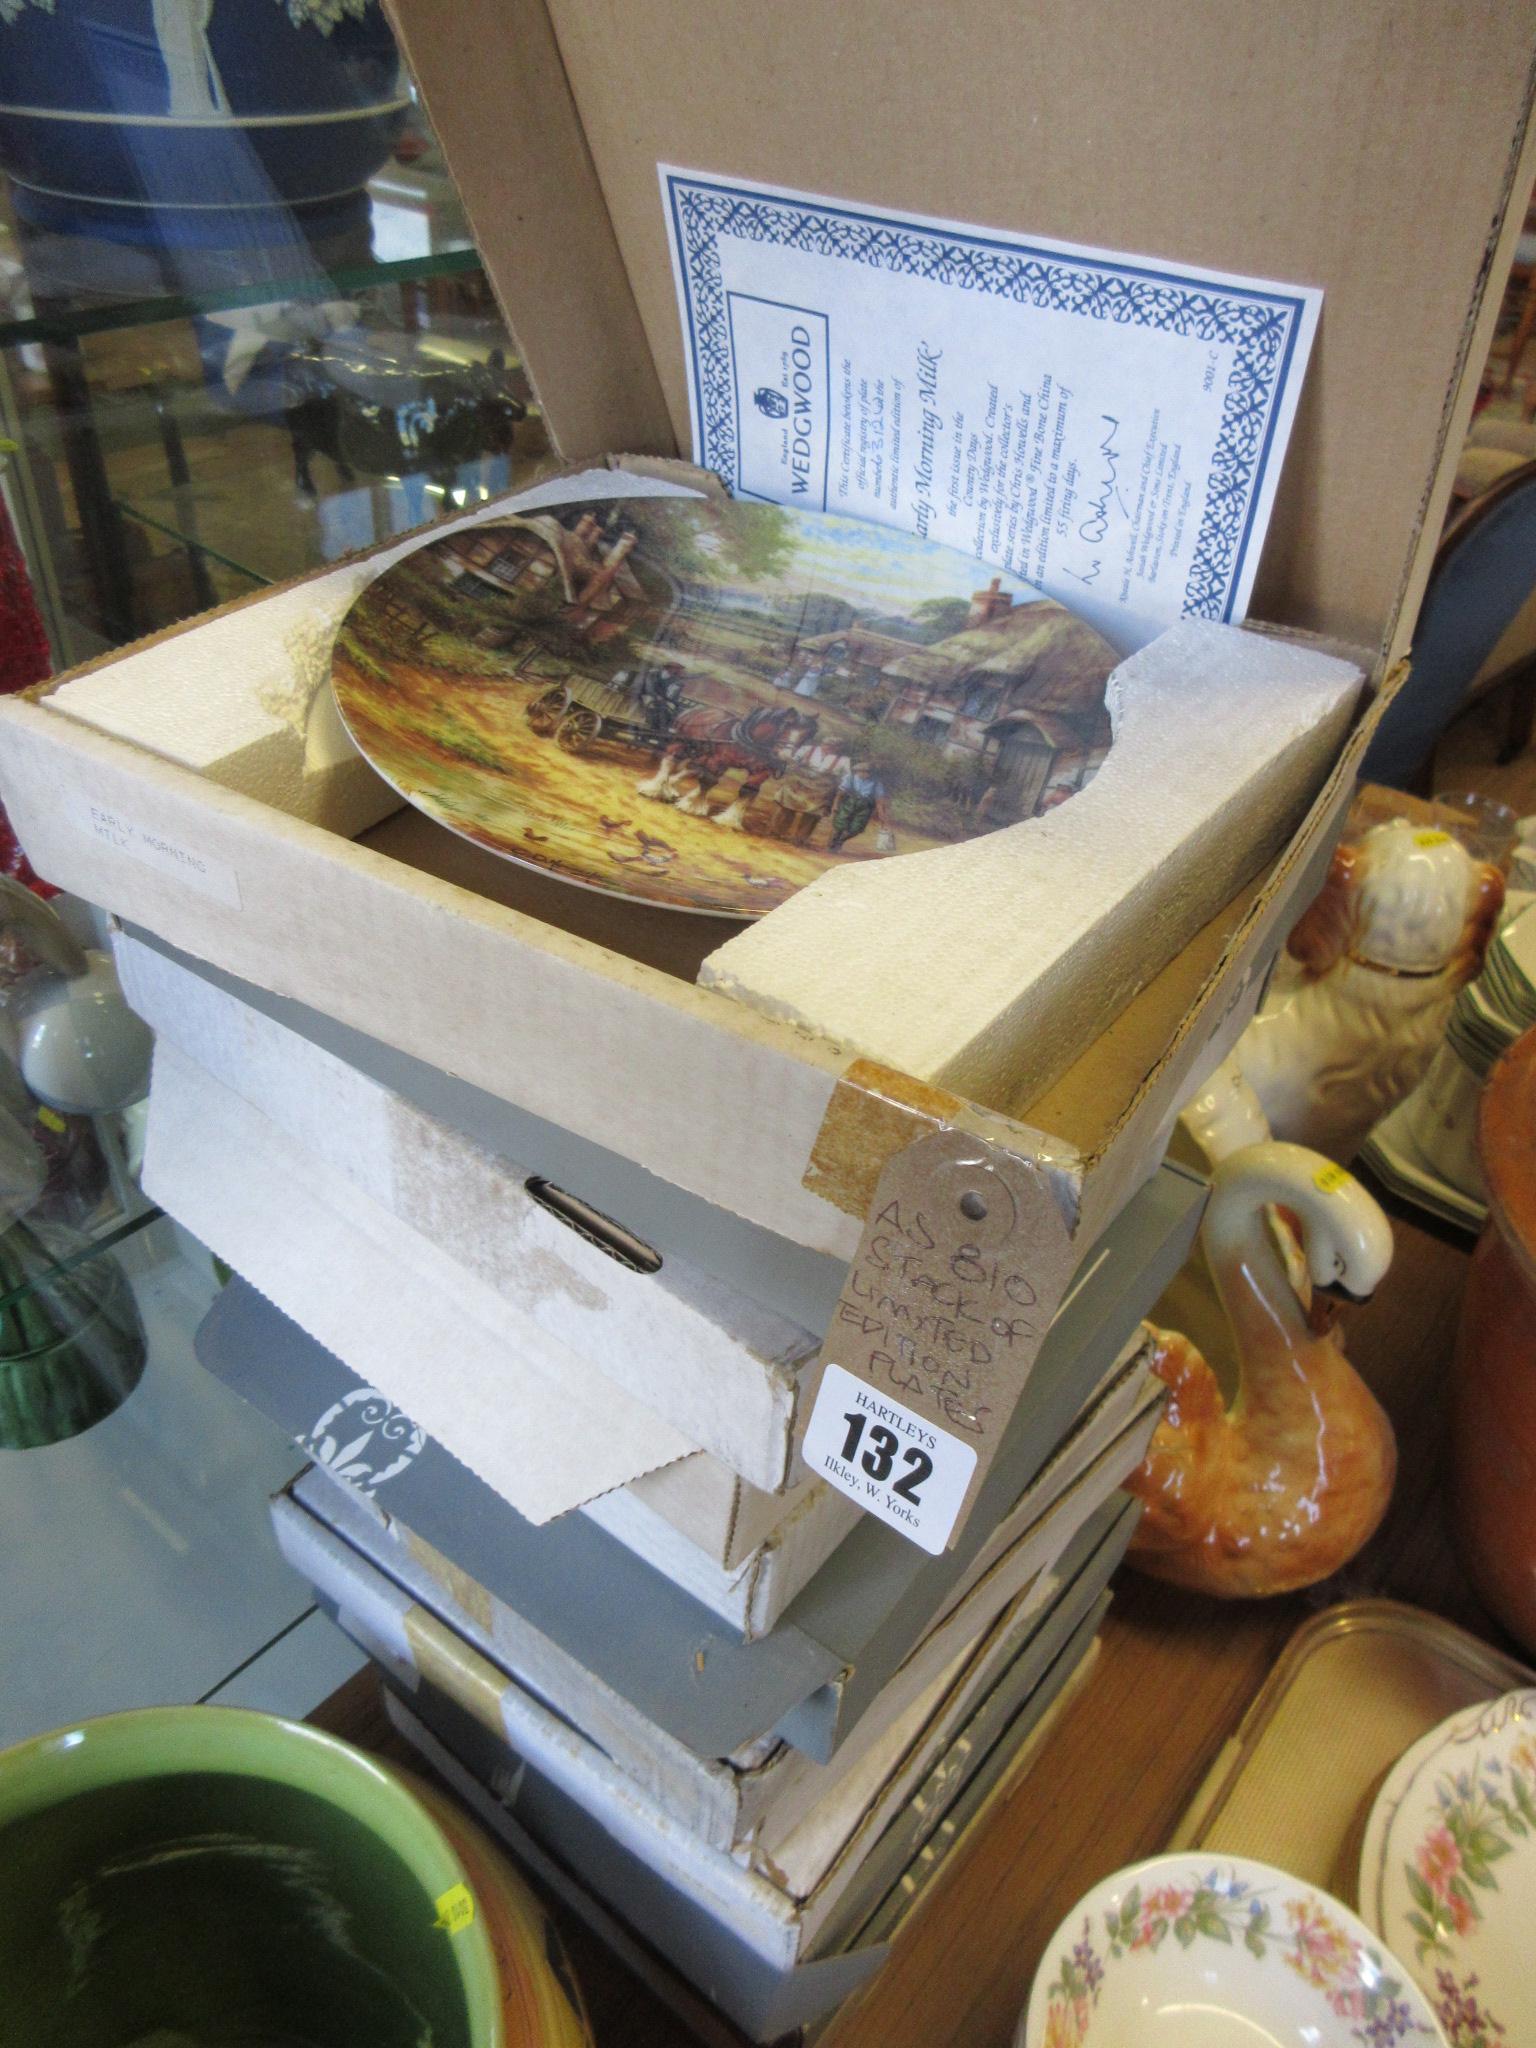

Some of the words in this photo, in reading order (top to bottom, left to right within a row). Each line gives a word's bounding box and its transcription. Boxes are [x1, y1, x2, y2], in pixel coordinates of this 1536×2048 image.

[842, 359, 851, 375] the
[859, 379, 870, 404] plate
[892, 378, 903, 391] of
[1038, 373, 1052, 411] China
[1056, 383, 1072, 399] of
[791, 326, 812, 494] WEDGWOOD
[859, 404, 868, 415] of
[891, 393, 901, 427] edition
[985, 382, 998, 428] Created
[1020, 391, 1031, 416] and
[858, 417, 869, 453] registry
[954, 411, 964, 430] the
[999, 402, 1013, 459] collector's
[1034, 413, 1048, 444] Bone
[1050, 402, 1067, 460] maximum
[841, 421, 853, 472] Certificate
[890, 429, 900, 464] limited
[914, 409, 942, 497] Morning
[953, 432, 963, 443] in
[967, 432, 981, 462] Days
[1013, 419, 1029, 466] Howells
[857, 456, 868, 490] official
[951, 446, 962, 473] issue
[997, 460, 1007, 478] the
[1028, 446, 1043, 473] Fine
[1049, 463, 1059, 471] a
[1063, 458, 1077, 486] days.
[838, 476, 849, 497] This
[889, 466, 899, 510] authentic
[948, 476, 961, 500] first
[964, 464, 978, 507] Country
[994, 480, 1008, 498] for
[1010, 468, 1023, 498] Chris
[1047, 473, 1059, 484] to
[947, 500, 958, 517] the
[978, 497, 990, 510] by
[1007, 499, 1021, 513] by
[1019, 485, 1038, 544] Wedgwood
[1040, 486, 1056, 524] limited
[1057, 488, 1076, 521] firing
[974, 512, 986, 560] collection
[990, 498, 1004, 554] exclusively
[1004, 515, 1017, 544] series
[1056, 522, 1067, 537] 55
[1002, 545, 1014, 570] plate
[1019, 547, 1030, 559] in
[1035, 527, 1051, 563] edition
[1035, 564, 1045, 578] an
[865, 1235, 988, 1325] STACK
[852, 1269, 993, 1365] LIMITED
[838, 1298, 971, 1390] EDITION
[868, 1350, 992, 1435] PLATES
[855, 1391, 938, 1450] HARTLEYS
[840, 1411, 934, 1507] 132
[823, 1455, 862, 1490] Ilkley,
[865, 1481, 881, 1503] W.
[885, 1494, 921, 1528] Yorks
